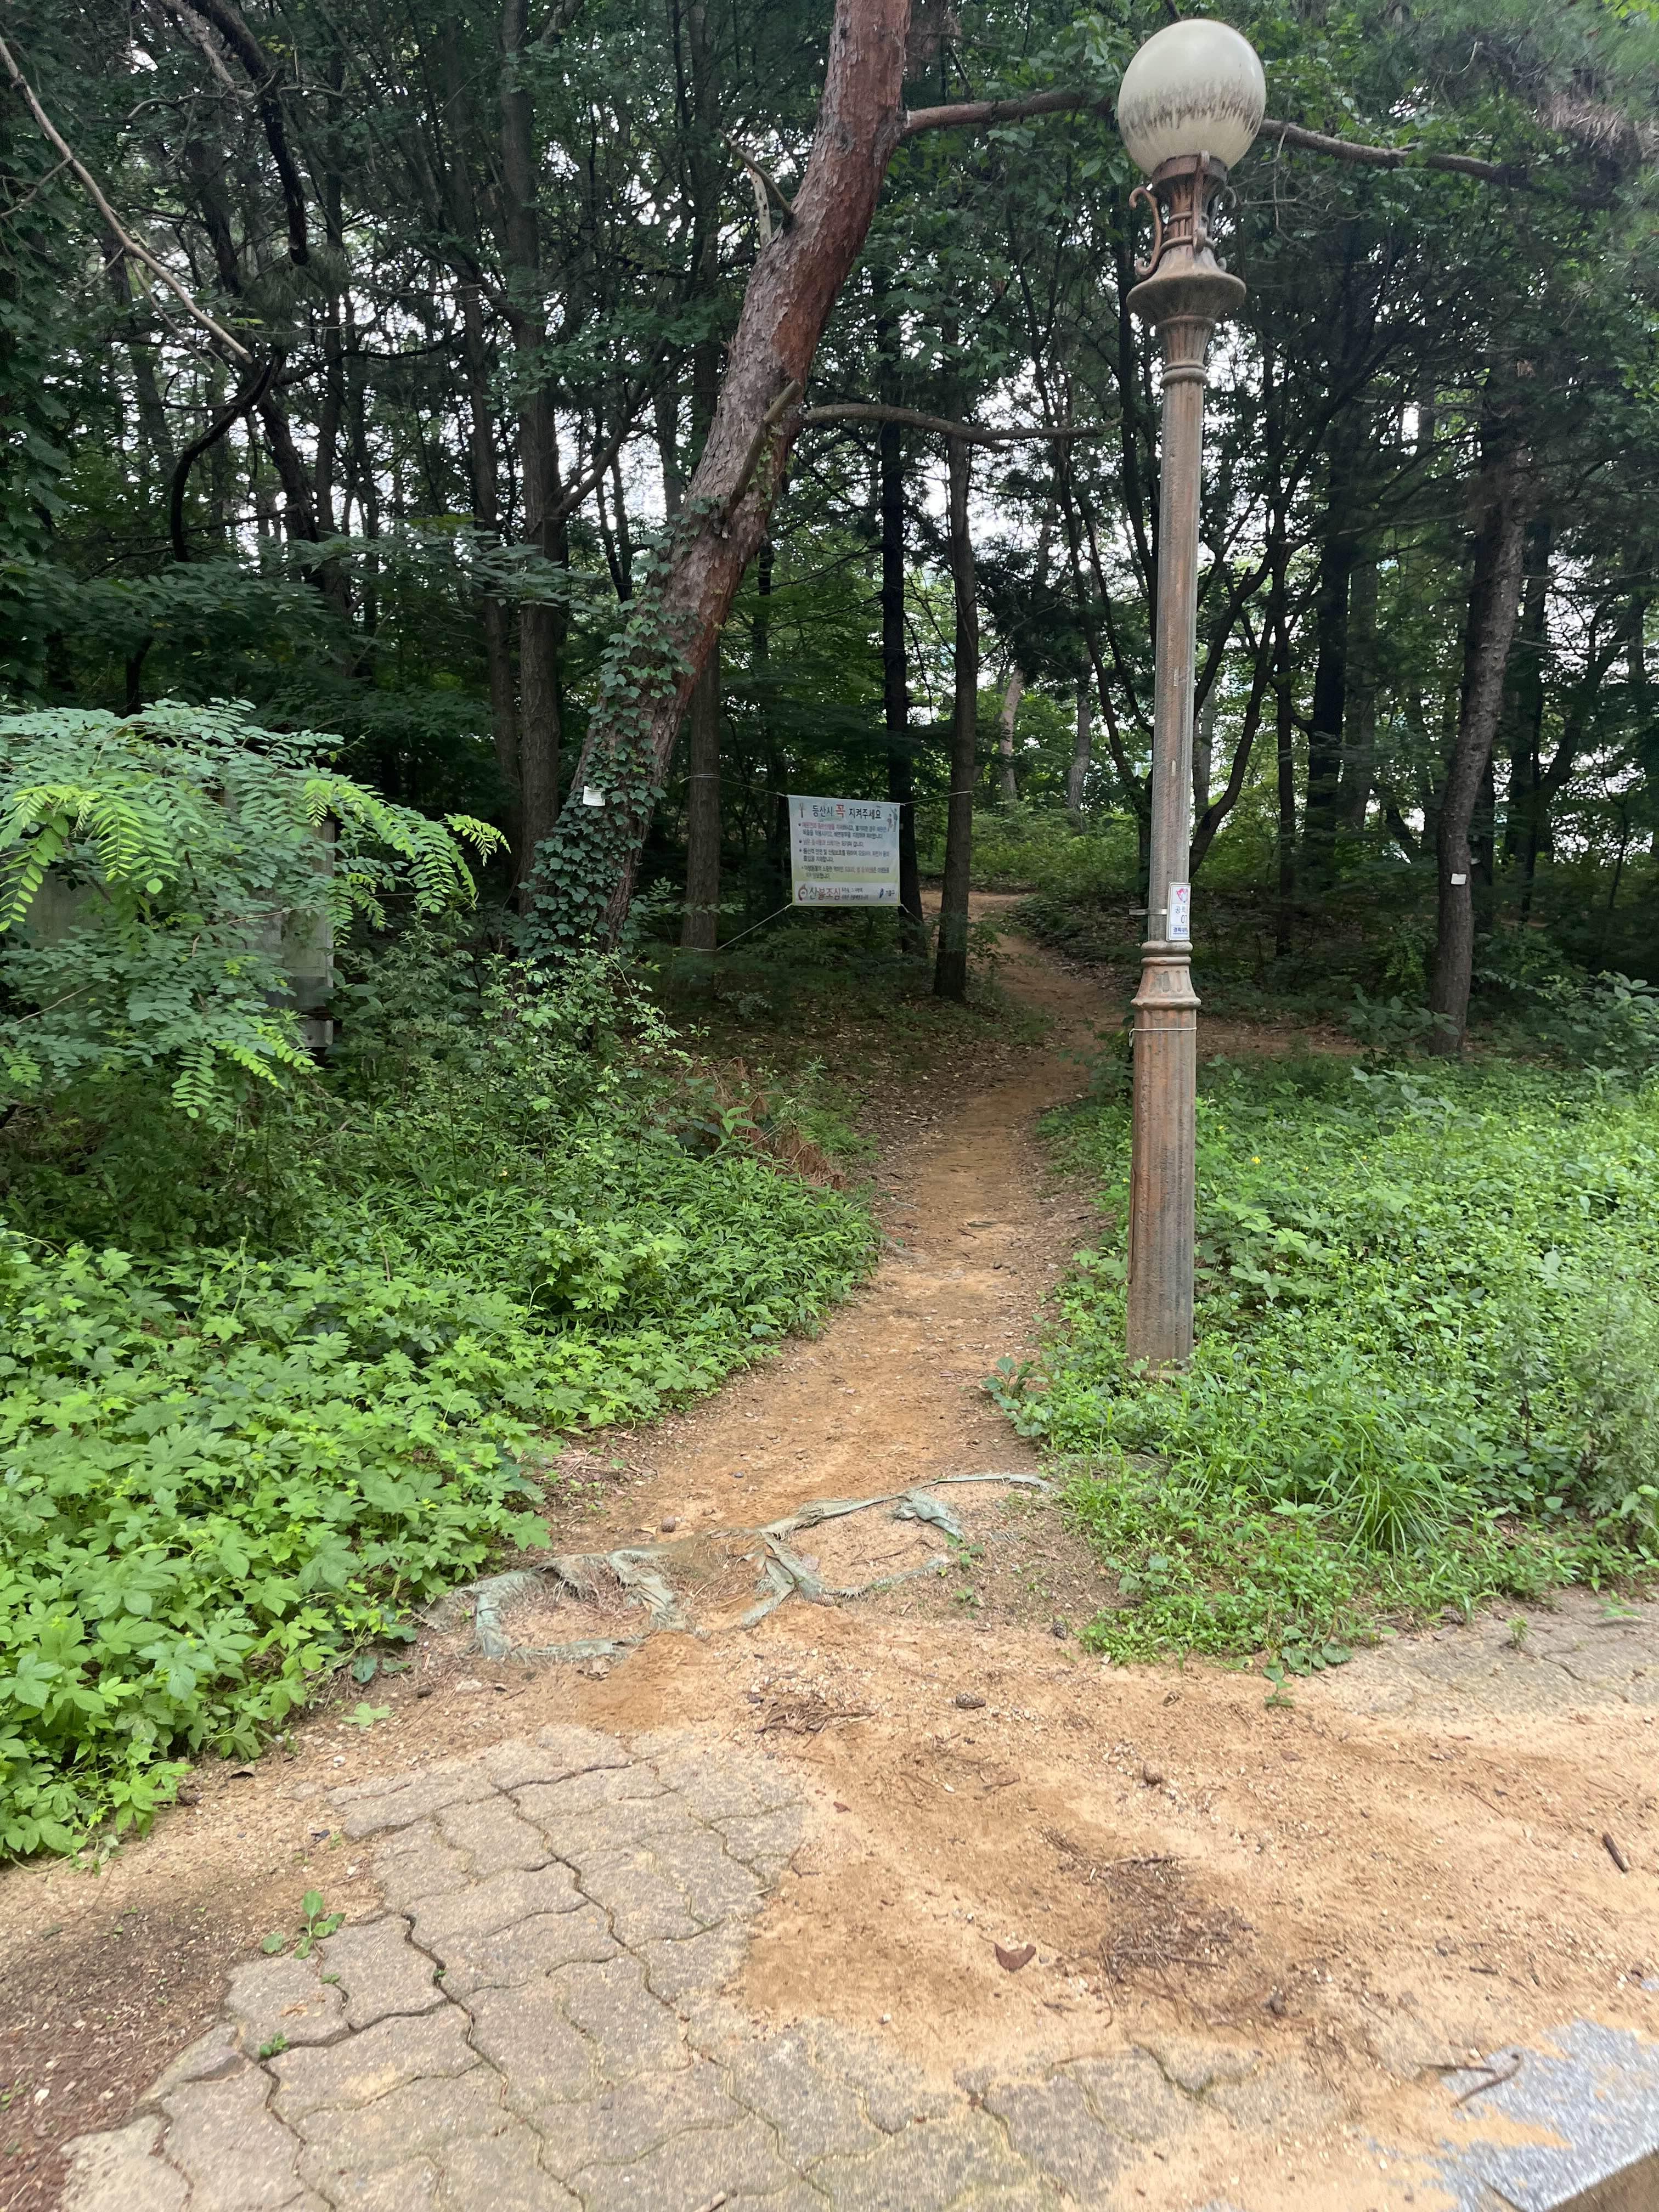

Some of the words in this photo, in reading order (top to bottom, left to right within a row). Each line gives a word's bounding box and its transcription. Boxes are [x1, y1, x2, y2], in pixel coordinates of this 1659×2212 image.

[812, 805, 833, 817] 등산시
[836, 804, 845, 818] 꼭
[849, 808, 882, 820] 지켜주세요
[809, 887, 840, 901] 산불조심
